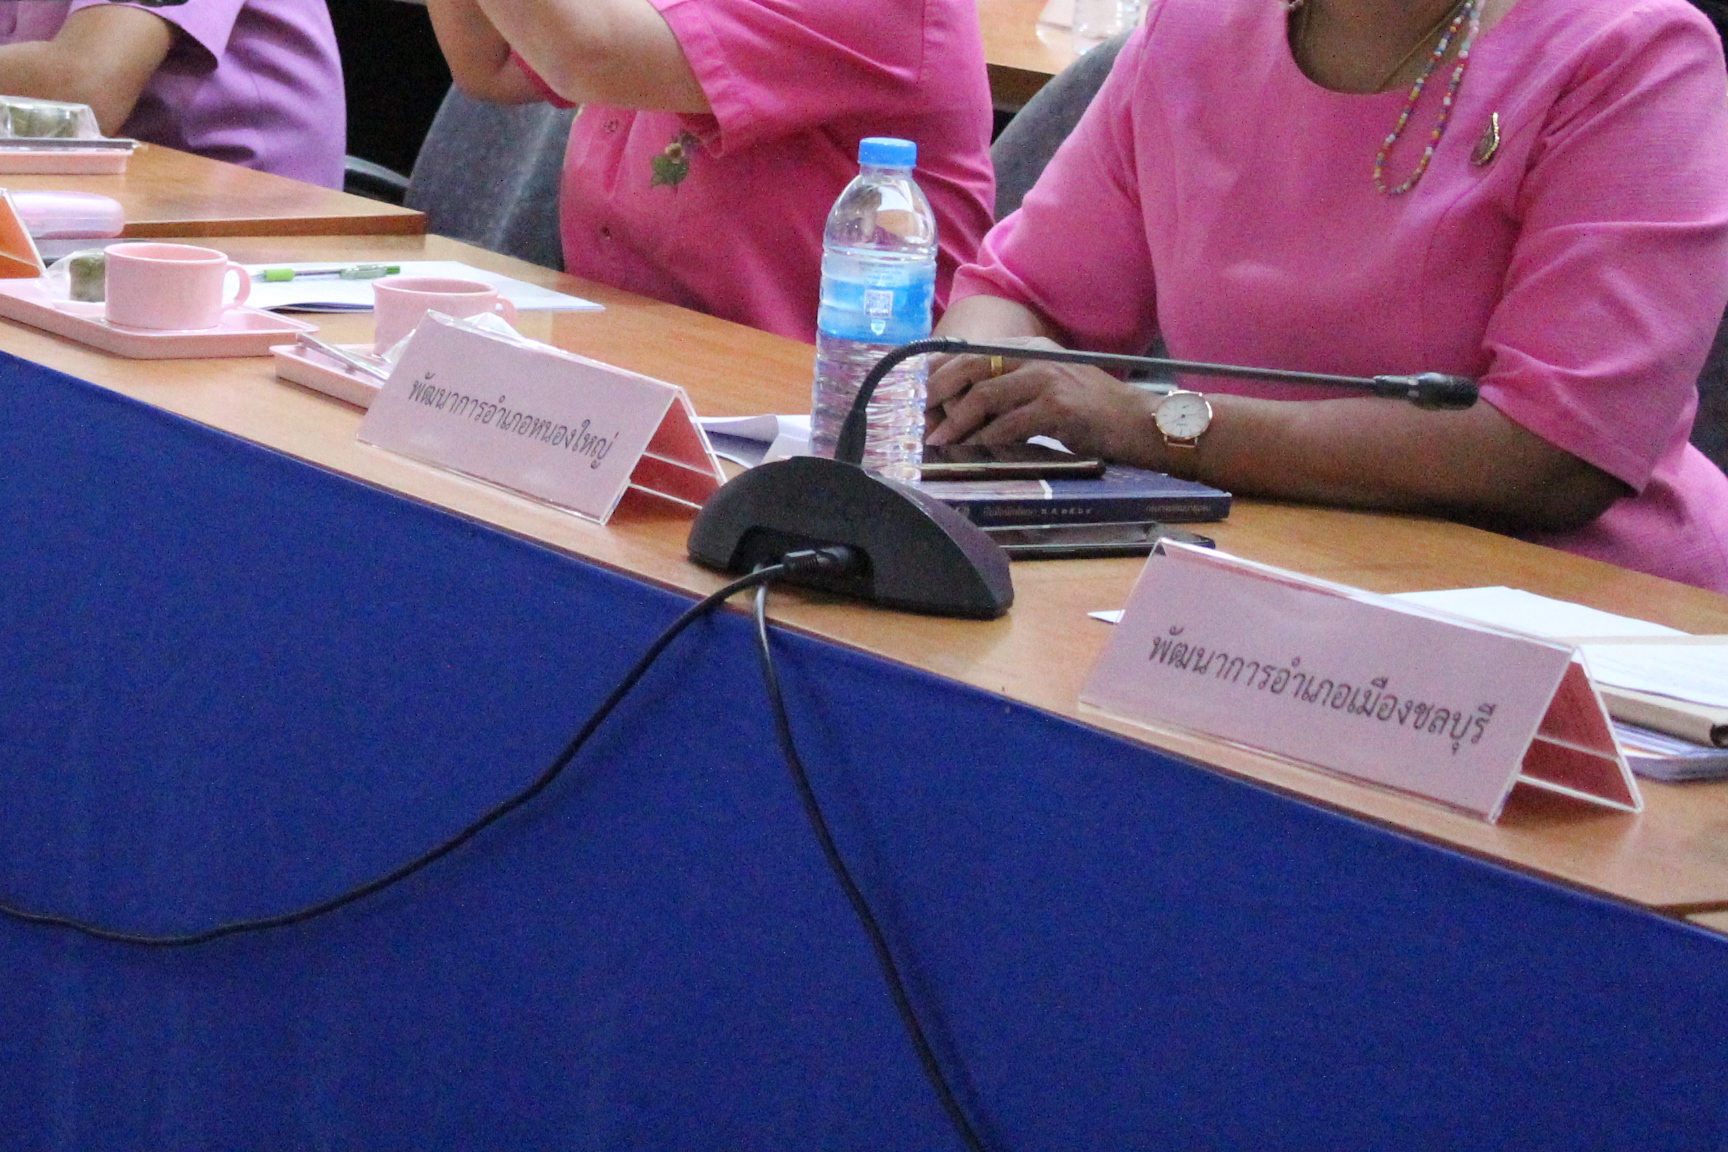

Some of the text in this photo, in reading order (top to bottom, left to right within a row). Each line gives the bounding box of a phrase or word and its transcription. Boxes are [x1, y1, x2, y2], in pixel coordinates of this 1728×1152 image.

[408, 371, 620, 469] พัฒนาการอำเภอหนองใหญ่
[1148, 626, 1497, 755] พัฒนาการอำเภอเมืองชลบุรี
